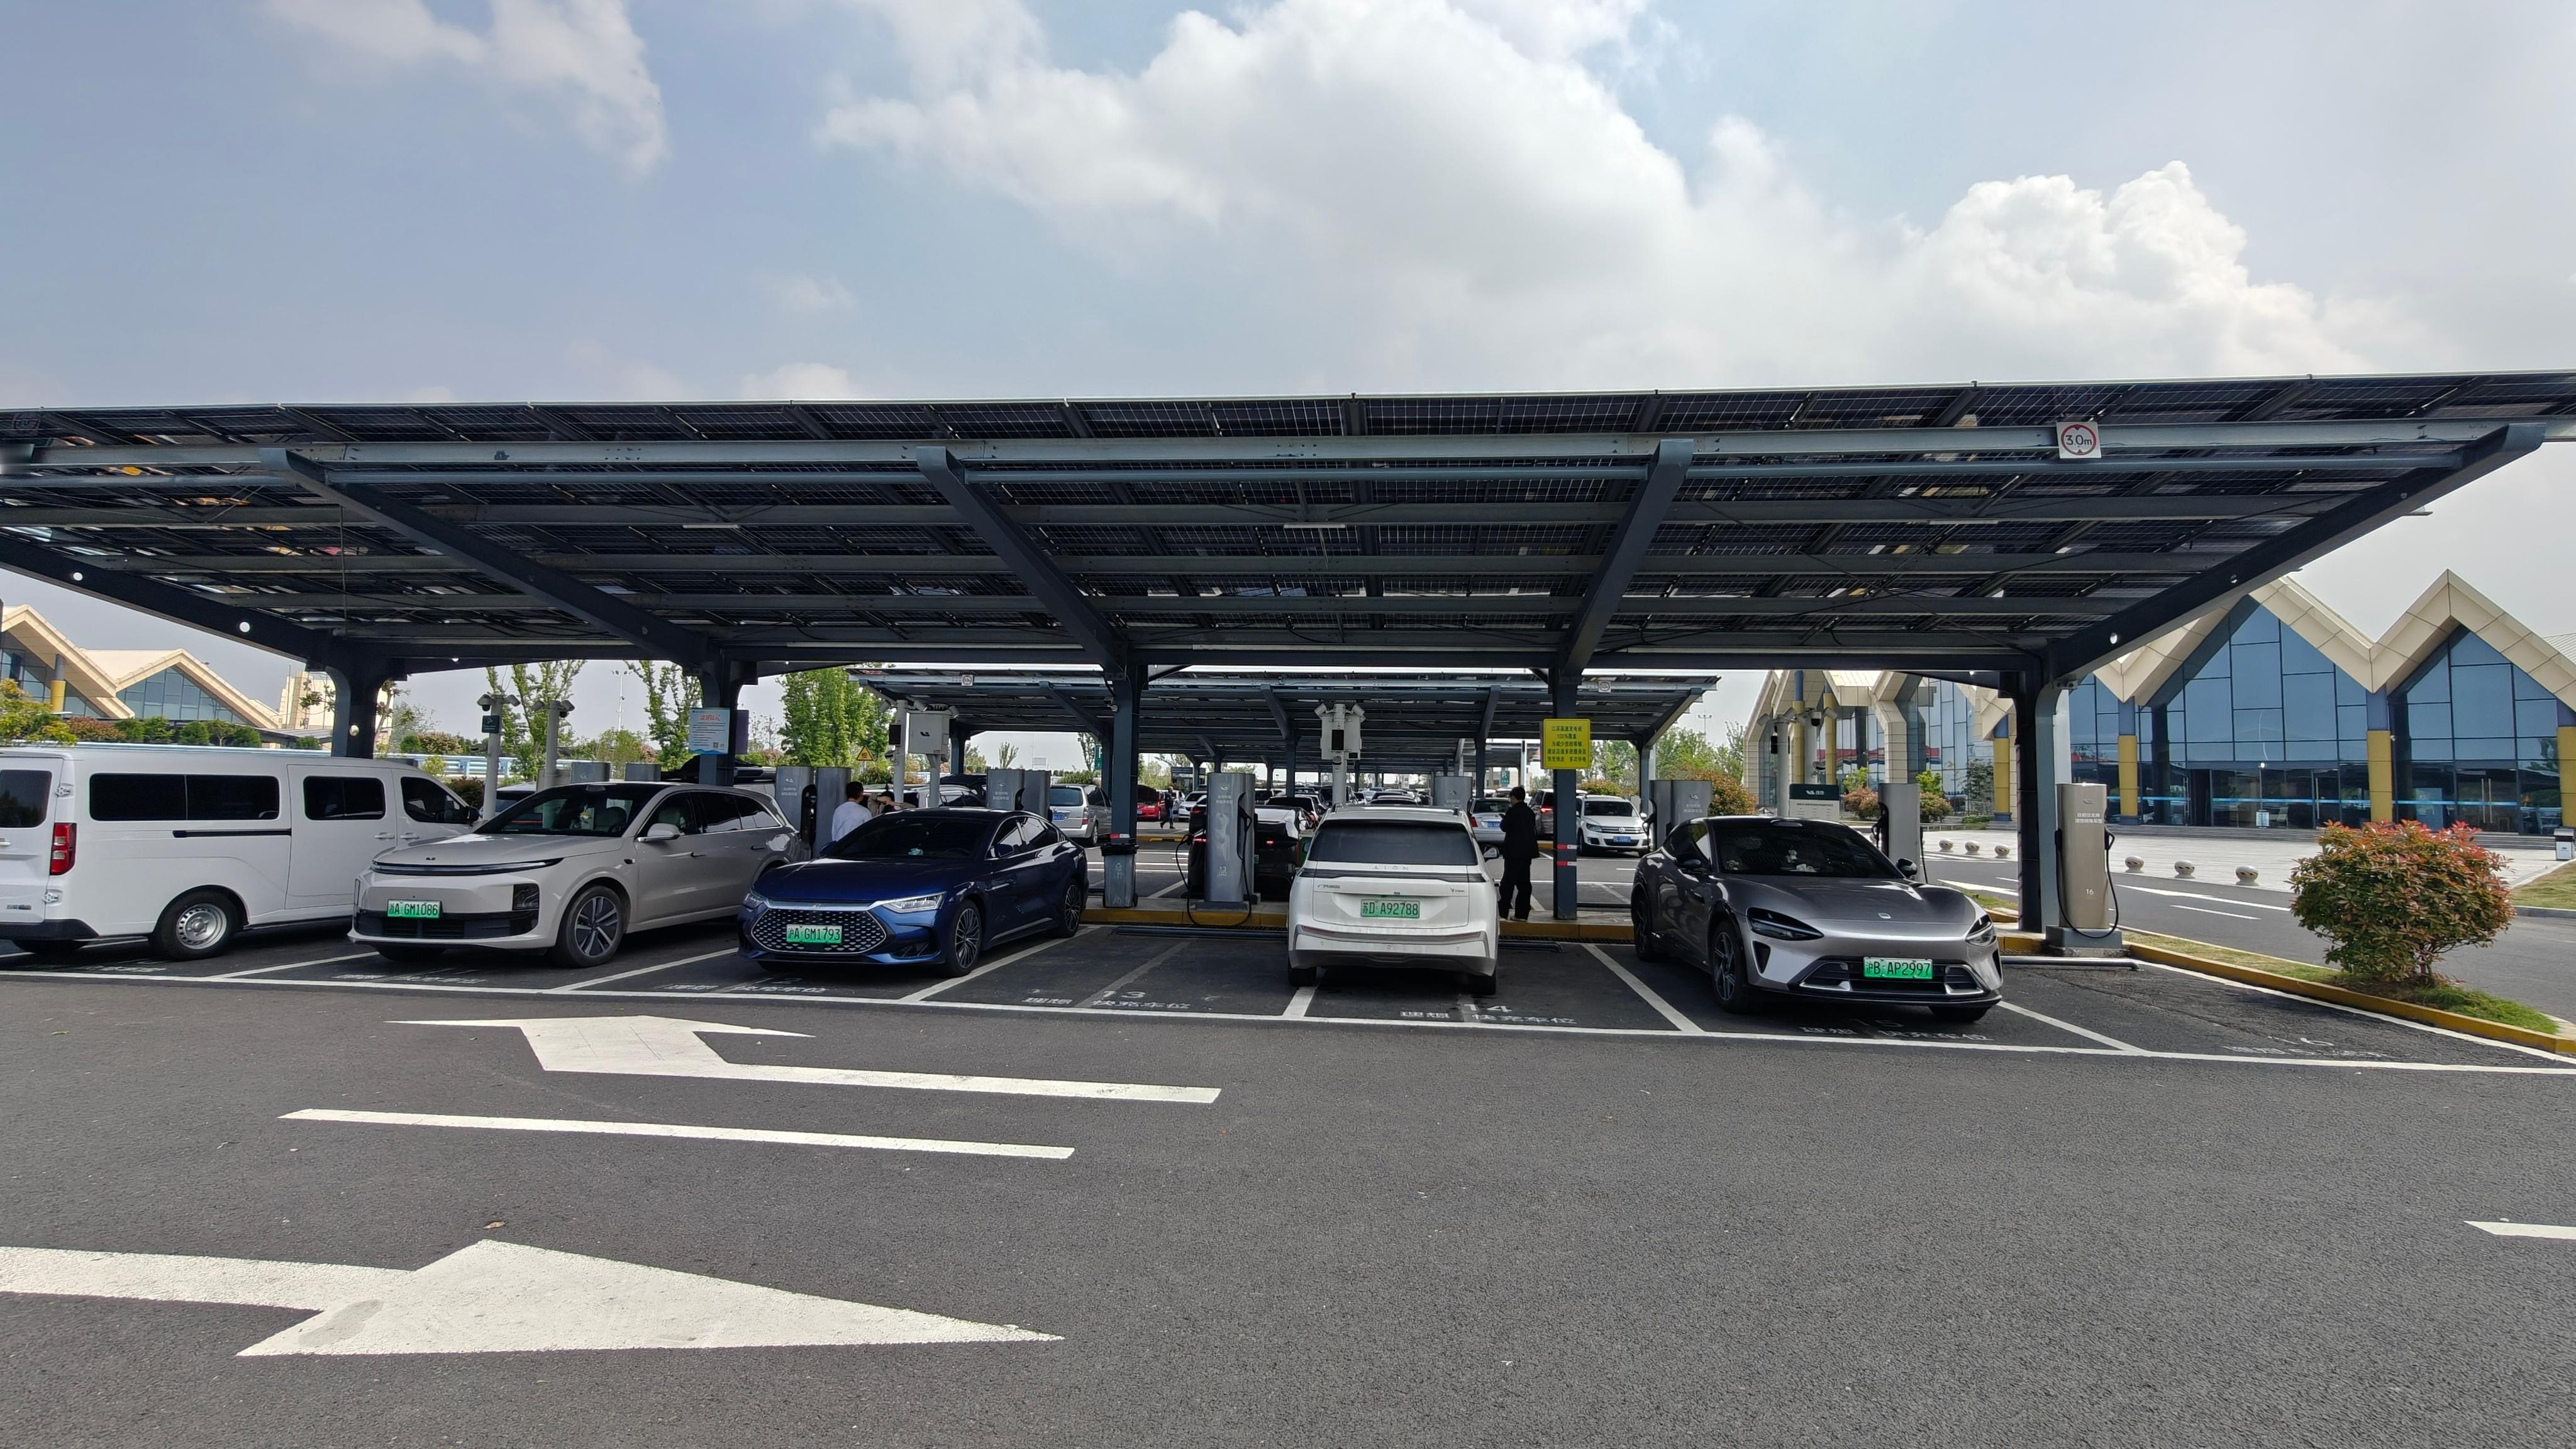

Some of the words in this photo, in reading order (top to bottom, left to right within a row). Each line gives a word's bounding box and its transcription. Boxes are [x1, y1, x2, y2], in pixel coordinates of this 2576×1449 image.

[2065, 435, 2092, 445] 3.0m
[1101, 991, 1146, 999] 13
[1463, 1004, 1513, 1013] 14
